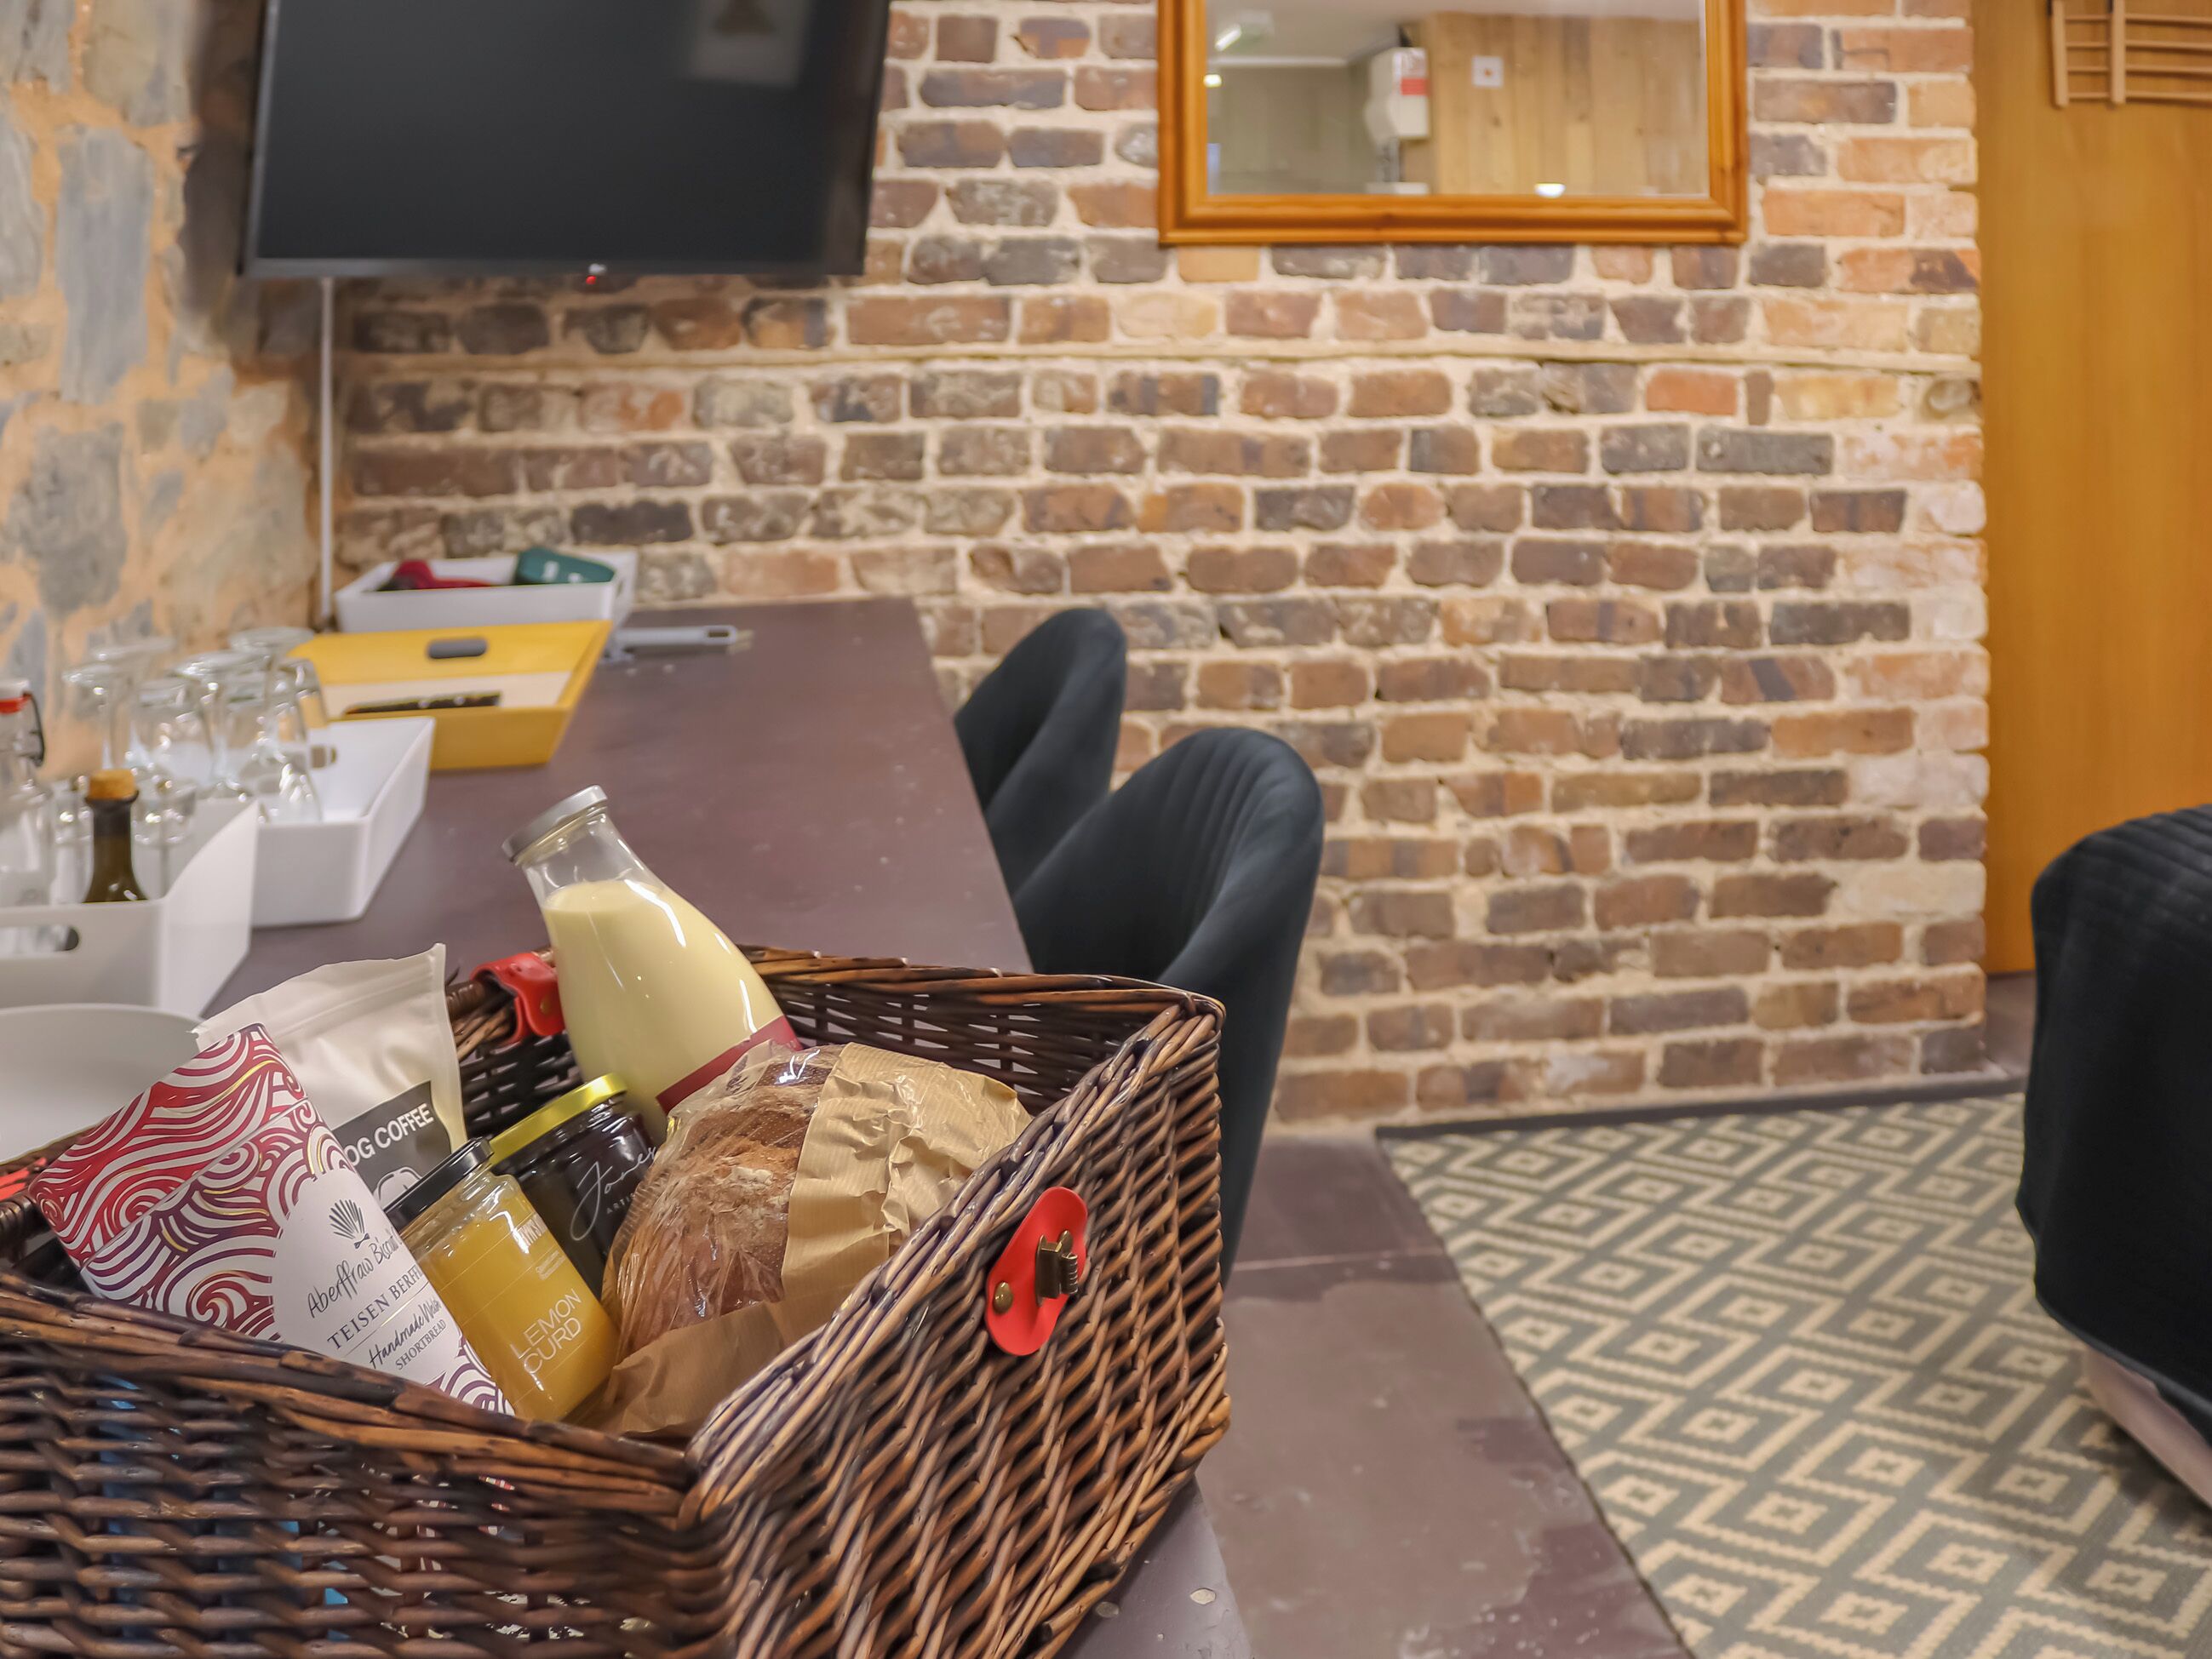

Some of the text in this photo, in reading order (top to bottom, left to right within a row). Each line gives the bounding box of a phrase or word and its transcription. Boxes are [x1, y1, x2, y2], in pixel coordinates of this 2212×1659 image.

[342, 1102, 434, 1166] OG COFFEE
[307, 1257, 374, 1319] Aberffraw
[327, 1294, 390, 1350] TEISEN
[369, 1313, 425, 1369] Handmade
[394, 1319, 447, 1370] SHORTBREAD
[510, 1288, 582, 1359] LEMON
[523, 1317, 582, 1374] CURD
